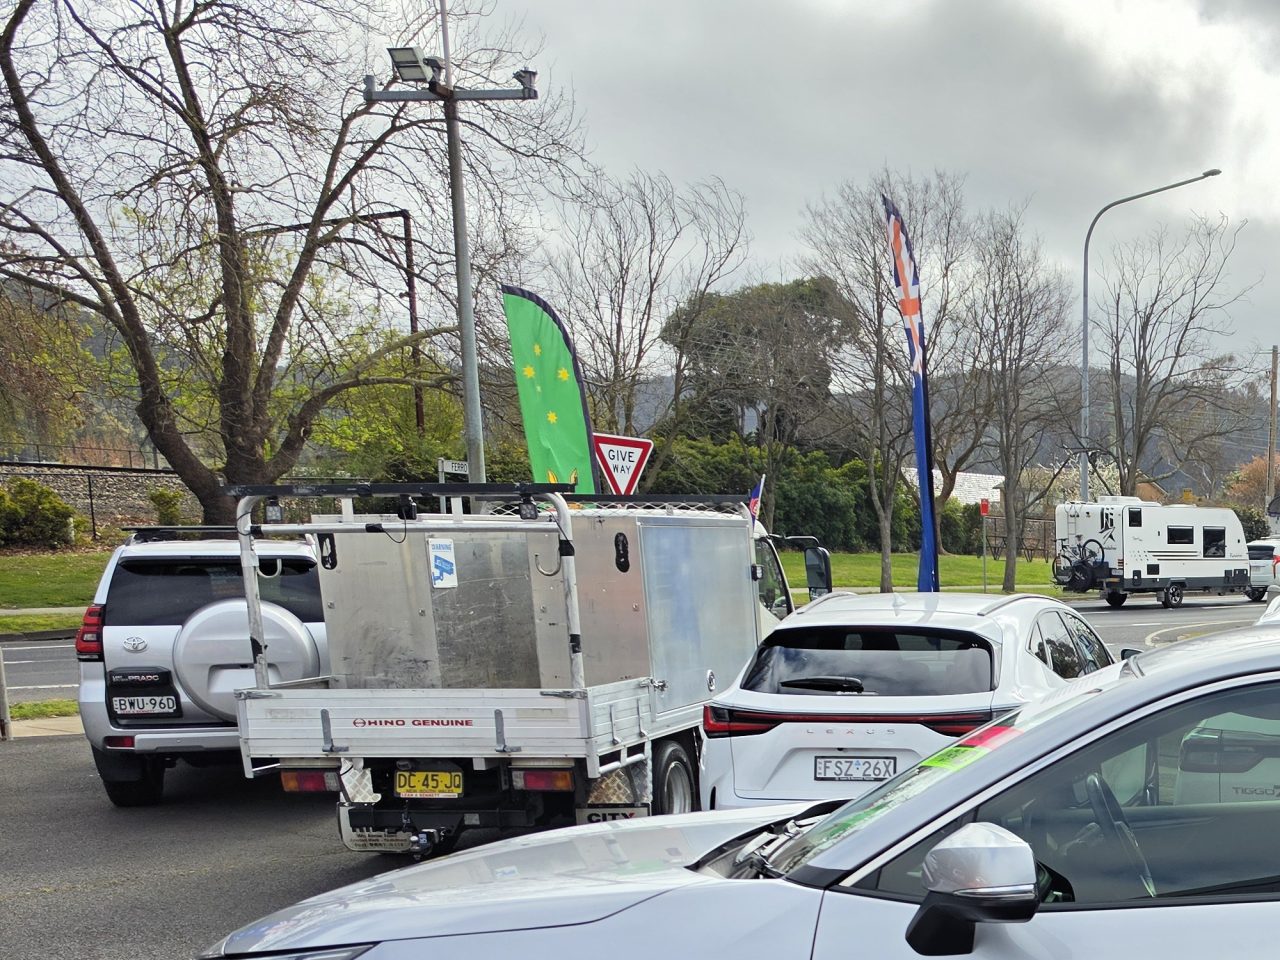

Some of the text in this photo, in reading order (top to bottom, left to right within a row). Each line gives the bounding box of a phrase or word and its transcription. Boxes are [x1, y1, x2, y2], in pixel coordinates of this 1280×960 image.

[608, 449, 635, 463] GIVE
[613, 464, 631, 475] WAY
[367, 719, 473, 727] HINO GENUINE
[806, 728, 896, 736] LEXUS
